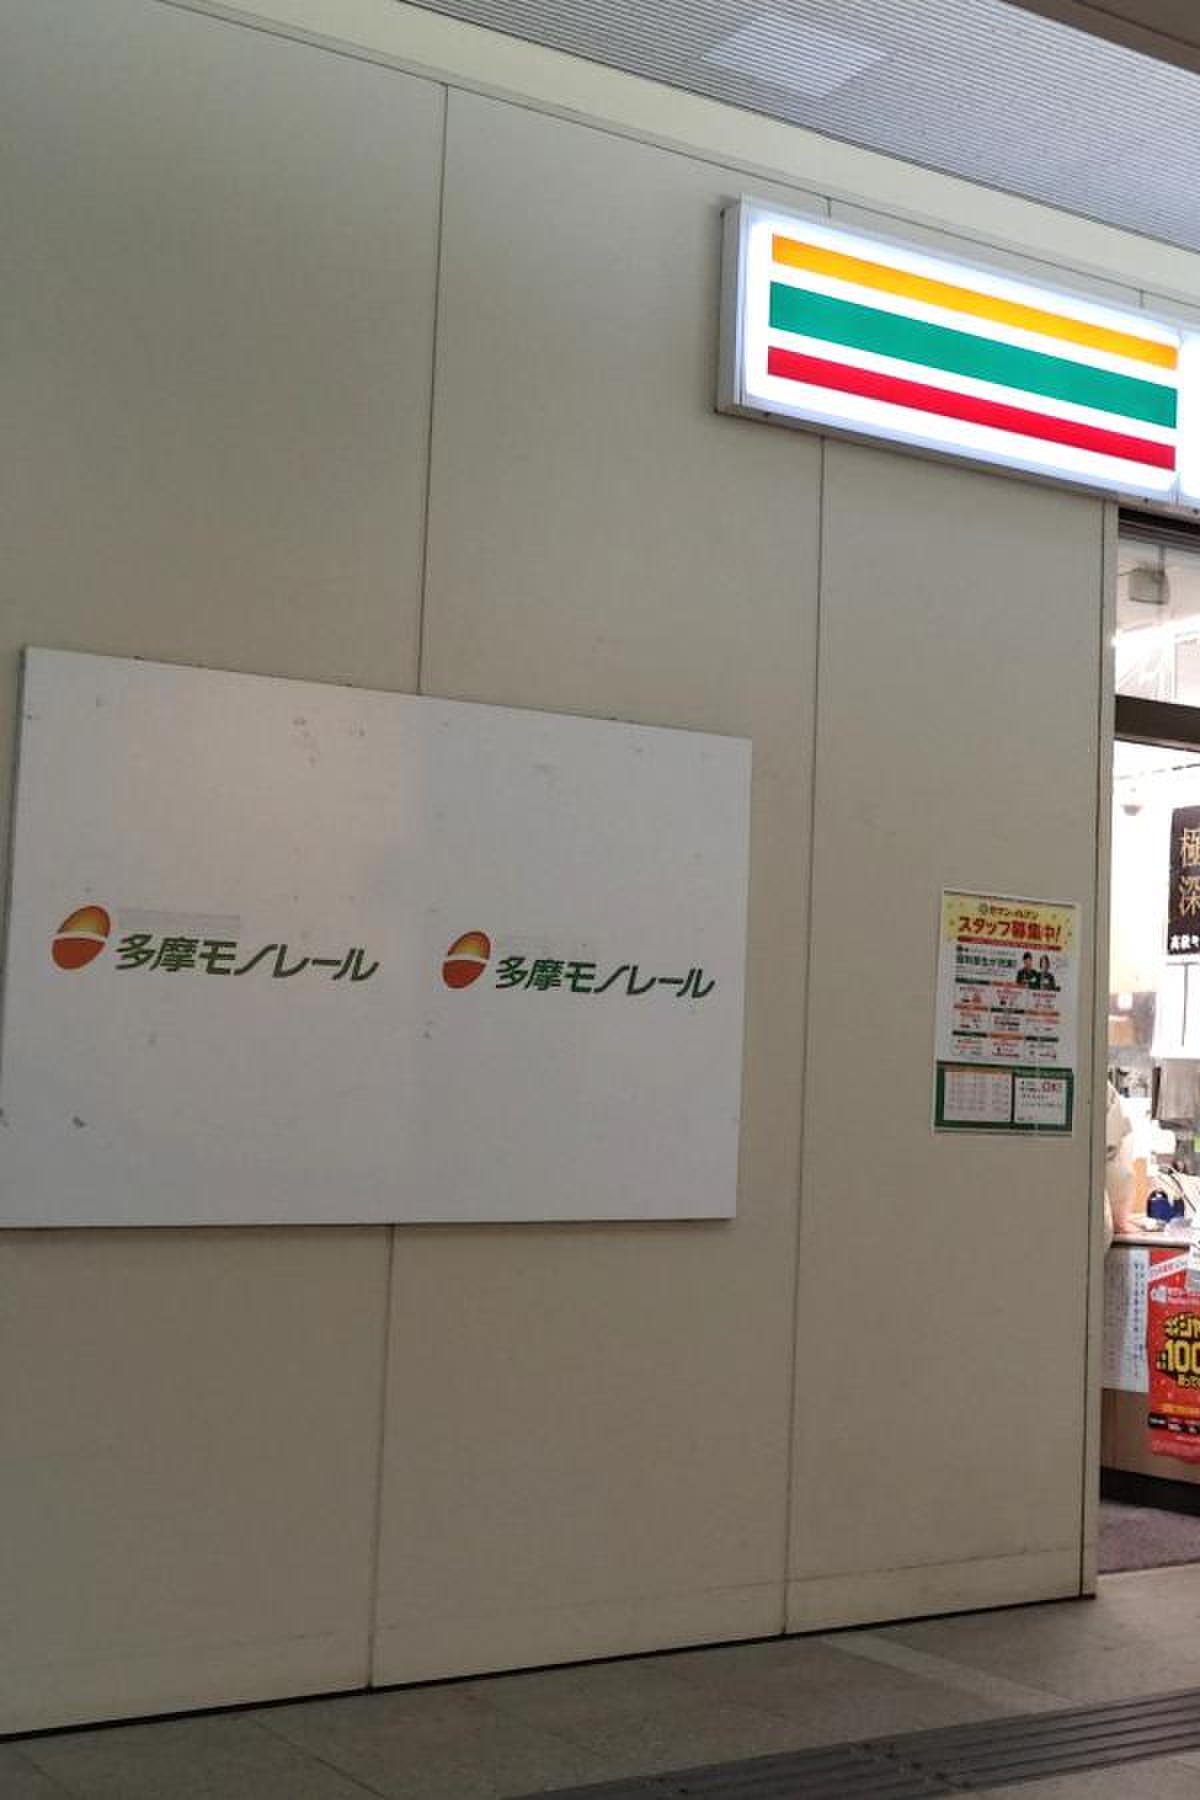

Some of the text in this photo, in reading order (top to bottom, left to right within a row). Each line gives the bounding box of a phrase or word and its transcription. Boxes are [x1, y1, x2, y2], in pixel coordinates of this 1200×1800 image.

[115, 933, 380, 982] 多摩モノレール
[495, 955, 716, 999] 多摩モノレール
